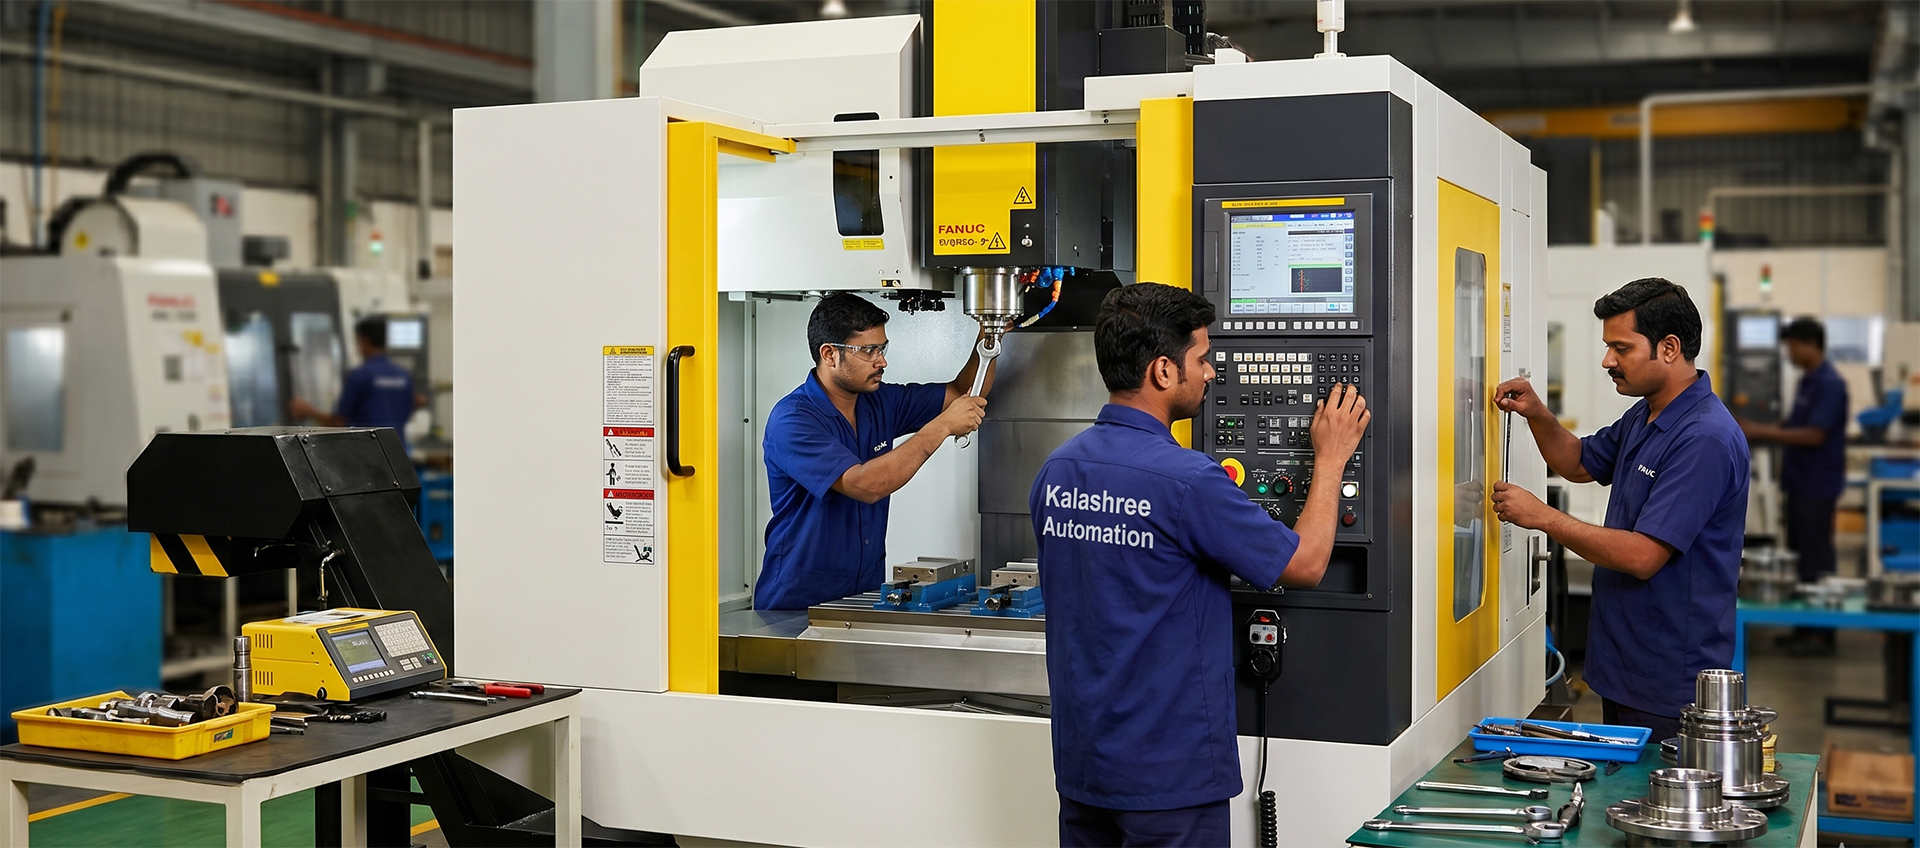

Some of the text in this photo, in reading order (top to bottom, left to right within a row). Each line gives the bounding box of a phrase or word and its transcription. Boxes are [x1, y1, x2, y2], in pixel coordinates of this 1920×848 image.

[938, 223, 986, 234] FANUC
[1045, 484, 1152, 517] Kalashree
[1042, 516, 1154, 549] Automation
